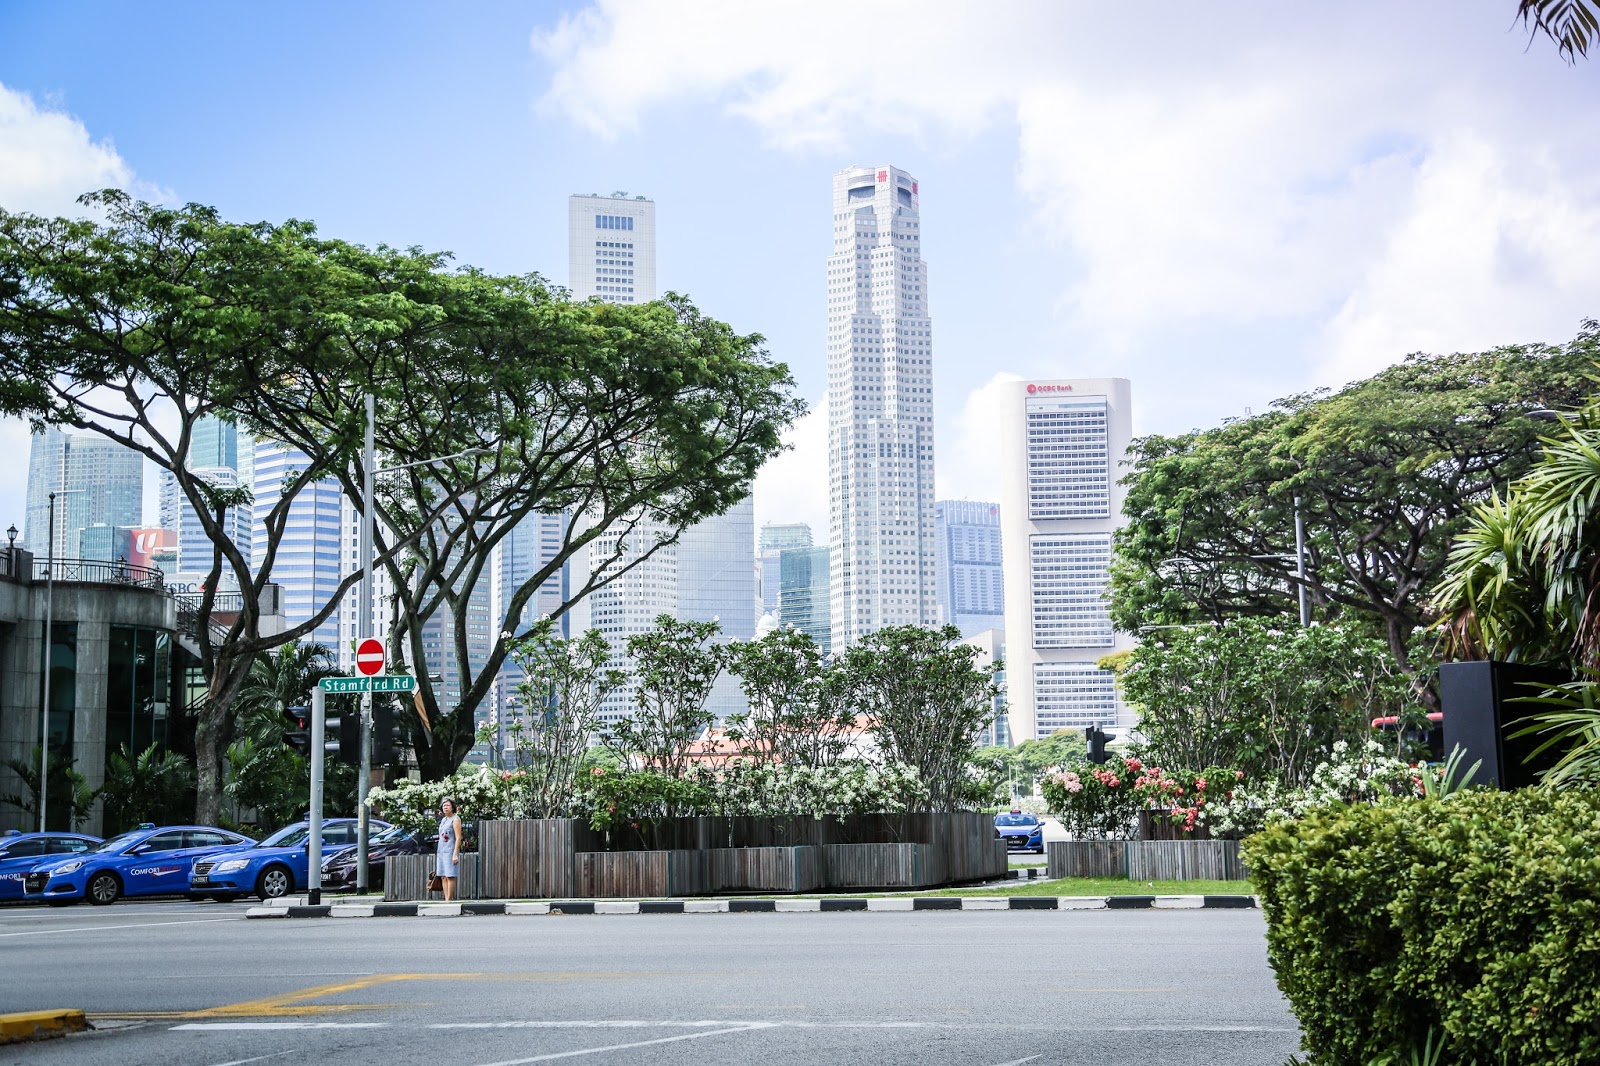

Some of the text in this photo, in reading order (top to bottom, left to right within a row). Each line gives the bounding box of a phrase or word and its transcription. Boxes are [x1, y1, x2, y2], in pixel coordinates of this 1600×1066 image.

[1057, 384, 1073, 392] Bank
[325, 677, 409, 692] Stamford Rd
